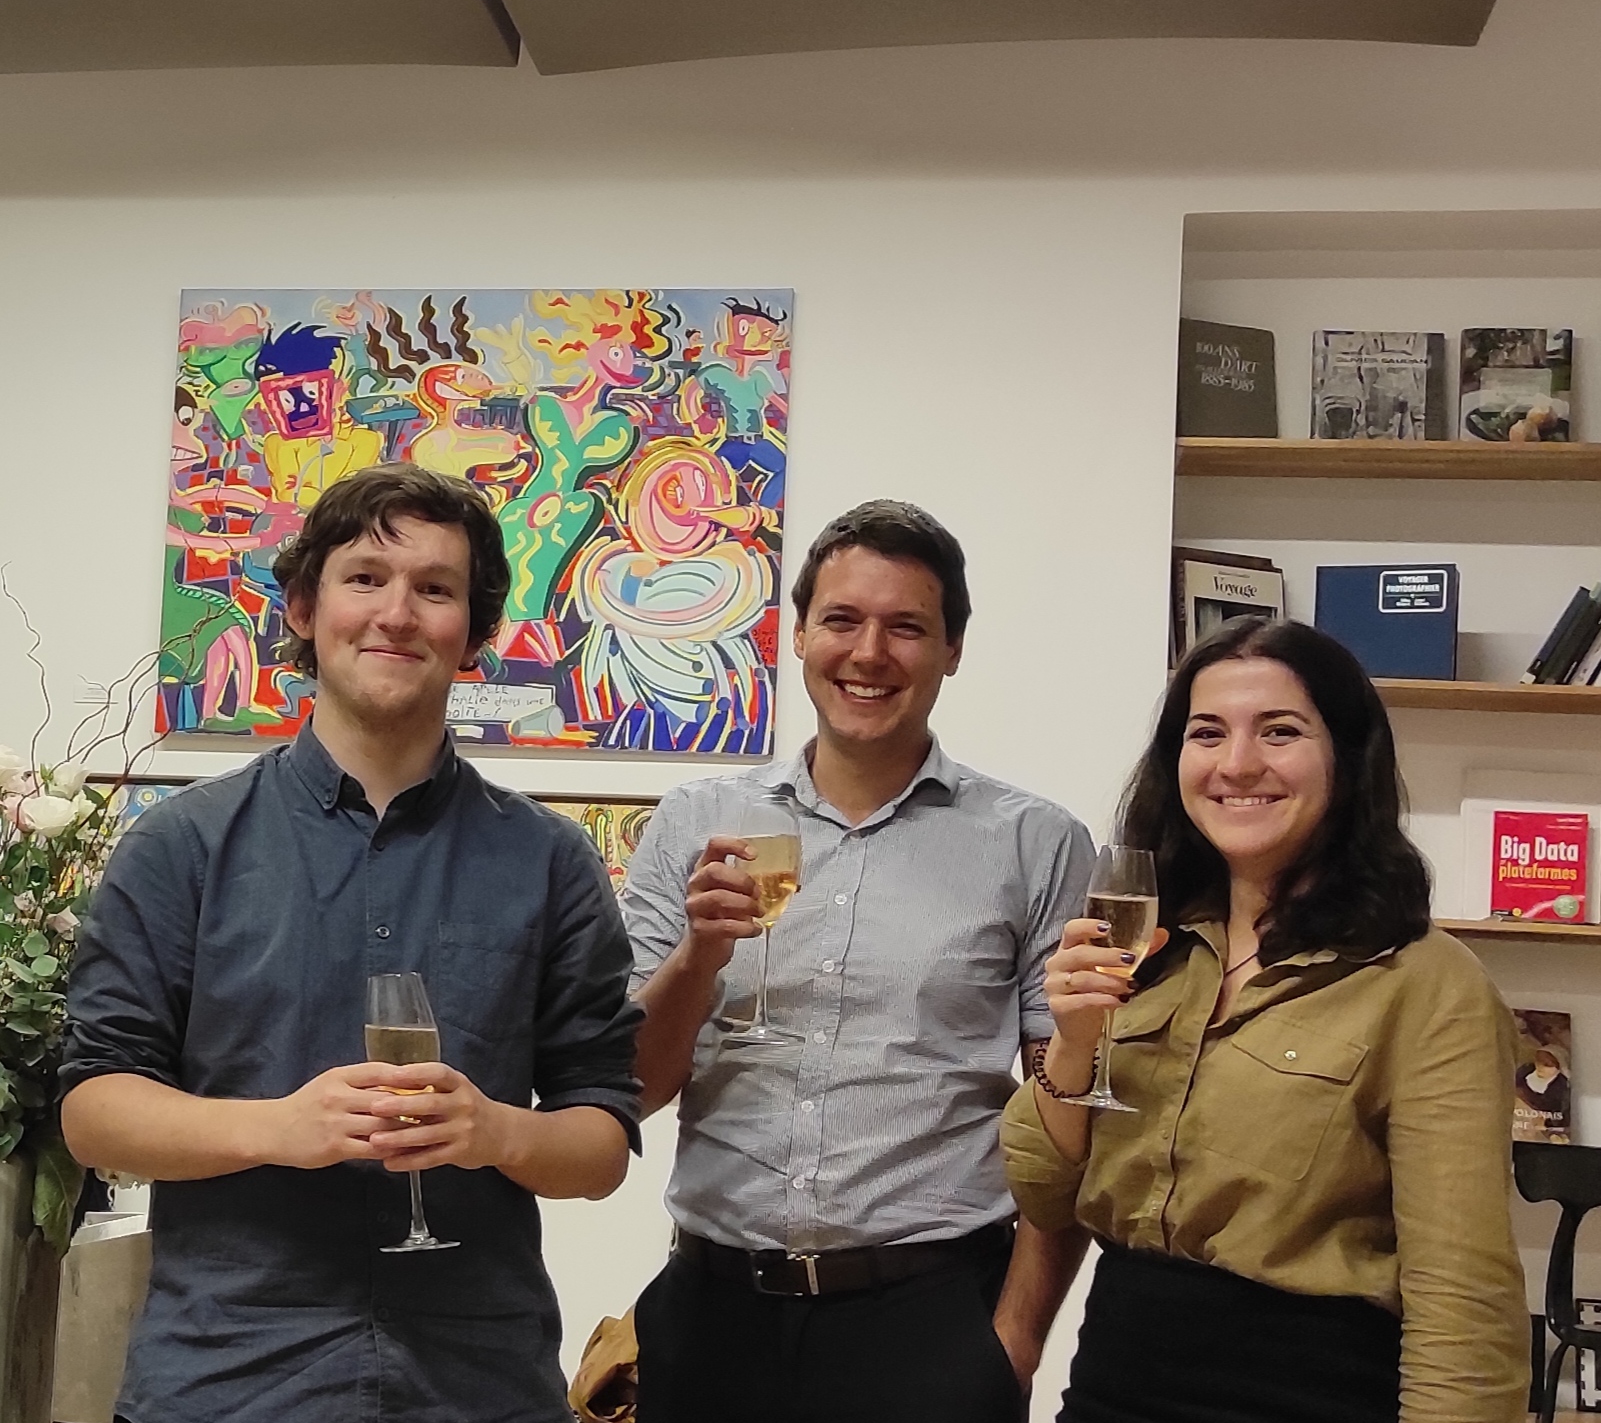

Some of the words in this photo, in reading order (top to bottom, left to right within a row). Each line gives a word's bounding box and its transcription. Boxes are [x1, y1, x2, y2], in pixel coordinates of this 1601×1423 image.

[1213, 575, 1258, 598] Voyage
[1500, 835, 1530, 865] Big
[1534, 836, 1579, 862] Data
[1498, 861, 1577, 881] plateformes
[1514, 1109, 1564, 1120] OLONAIS
